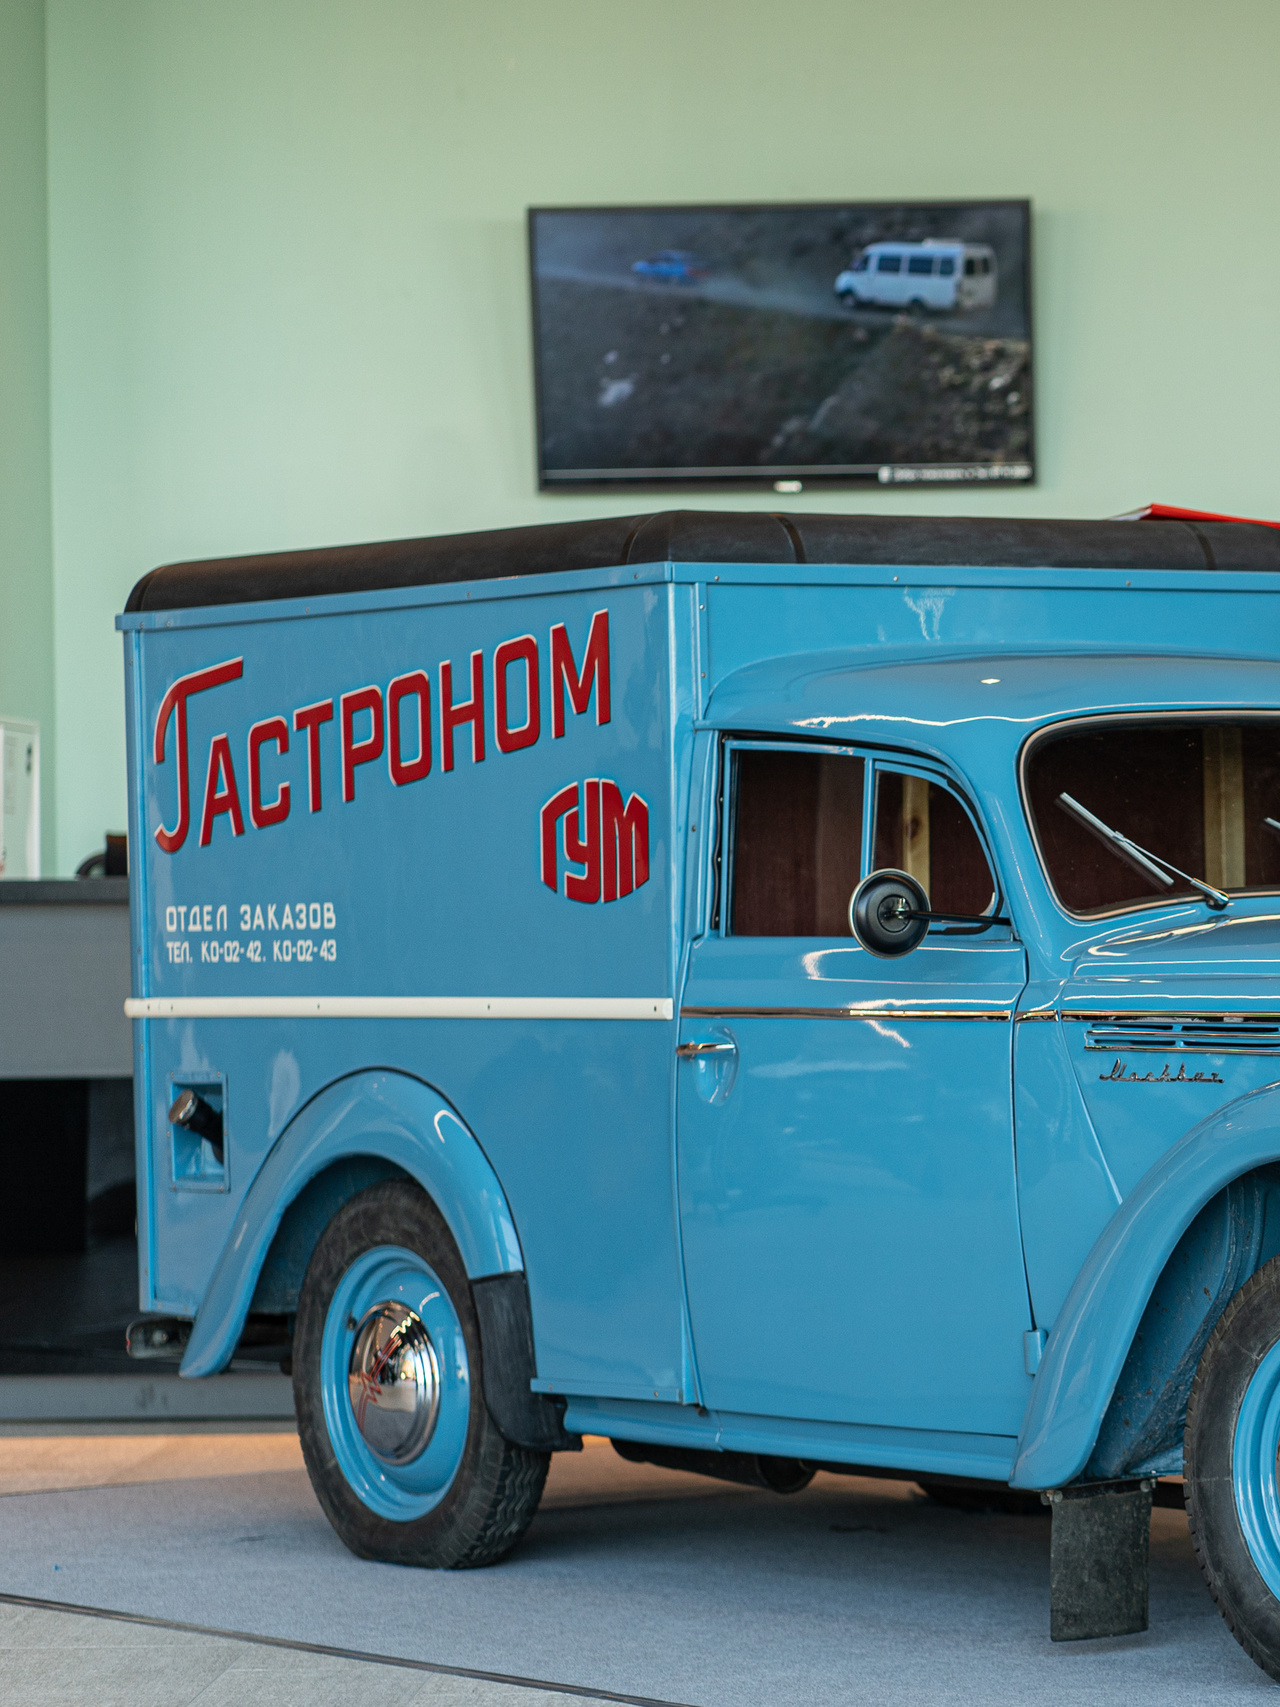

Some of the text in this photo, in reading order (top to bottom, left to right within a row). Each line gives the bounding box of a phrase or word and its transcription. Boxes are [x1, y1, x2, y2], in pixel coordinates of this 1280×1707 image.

[540, 778, 650, 904] ГУМ
[166, 902, 336, 932] ОТДЕЛ ЗАКАЗОВ
[166, 941, 193, 964] ТЕЛ.
